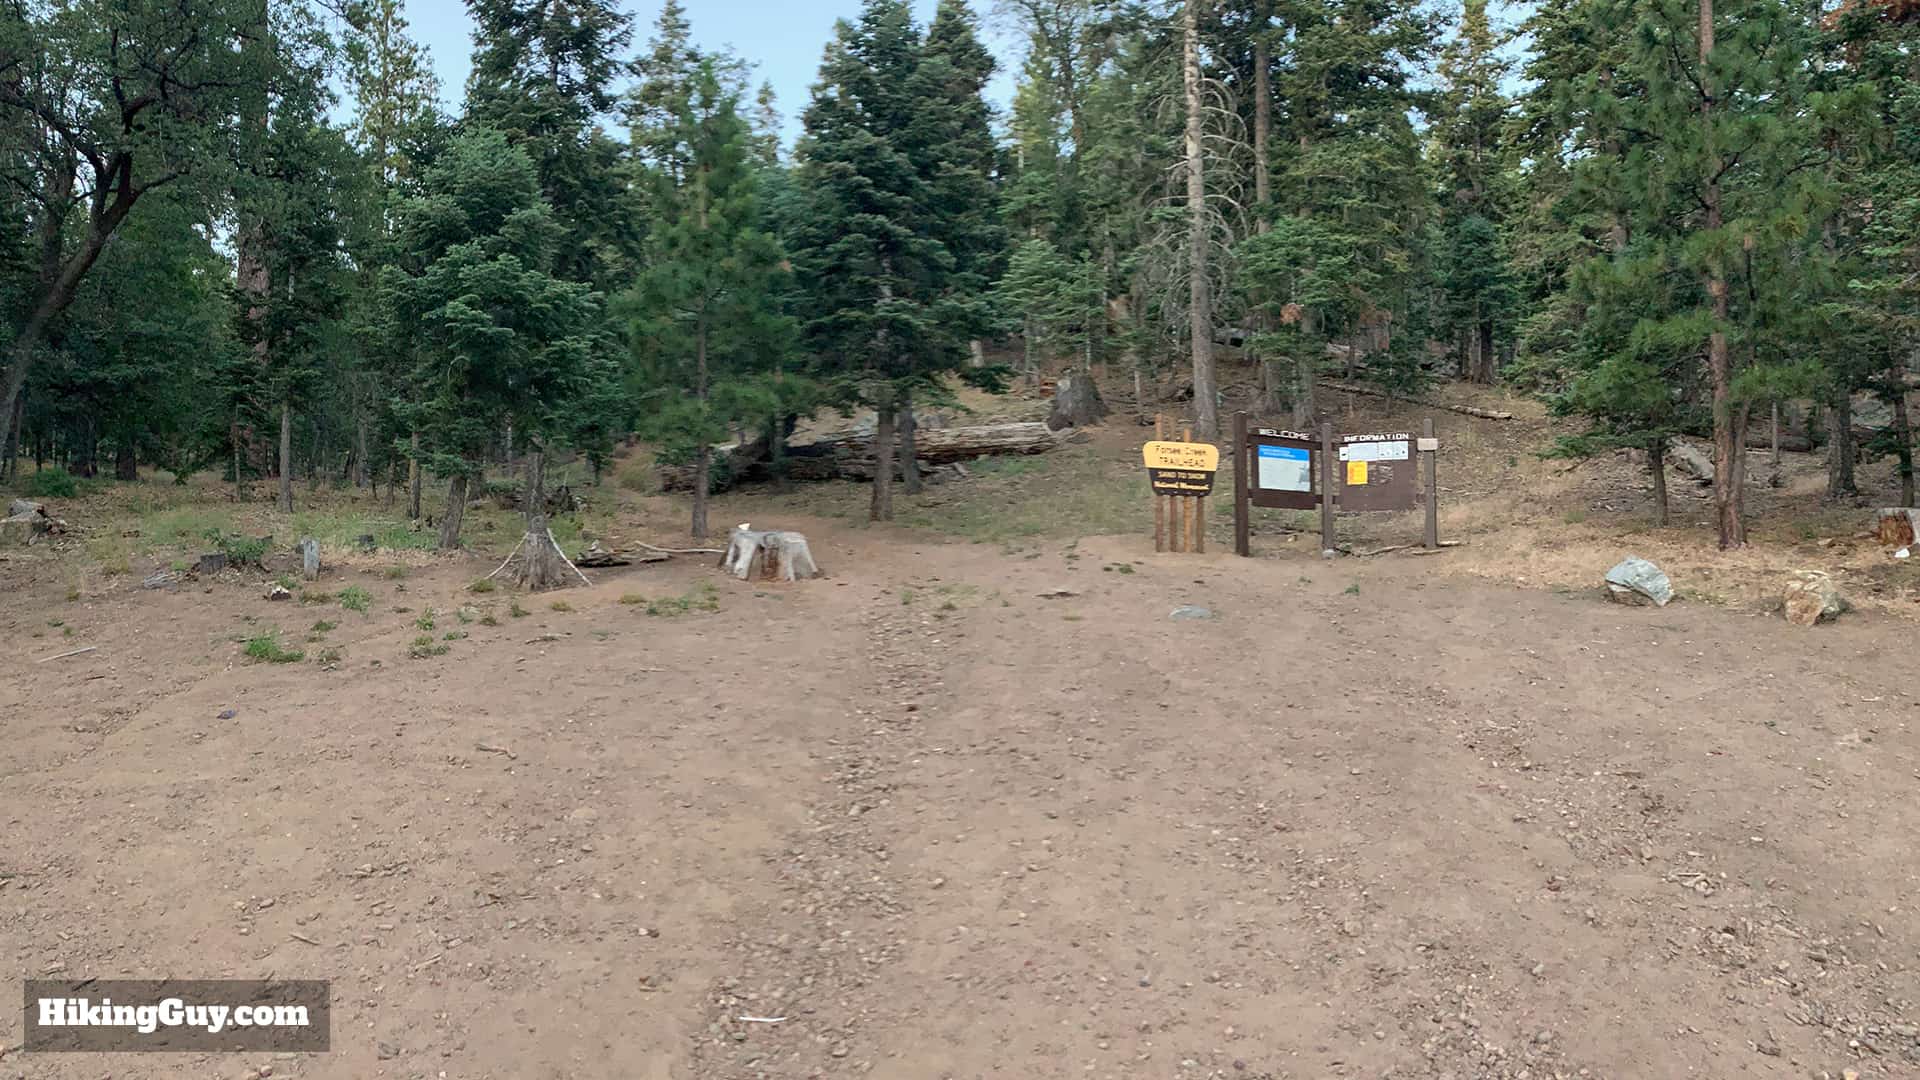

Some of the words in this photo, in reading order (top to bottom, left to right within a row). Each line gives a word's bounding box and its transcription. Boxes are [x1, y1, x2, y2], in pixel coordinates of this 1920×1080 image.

[1258, 428, 1312, 441] WELCOME
[1344, 432, 1410, 443] INFORMATION
[1159, 456, 1206, 468] TRAILHEAD
